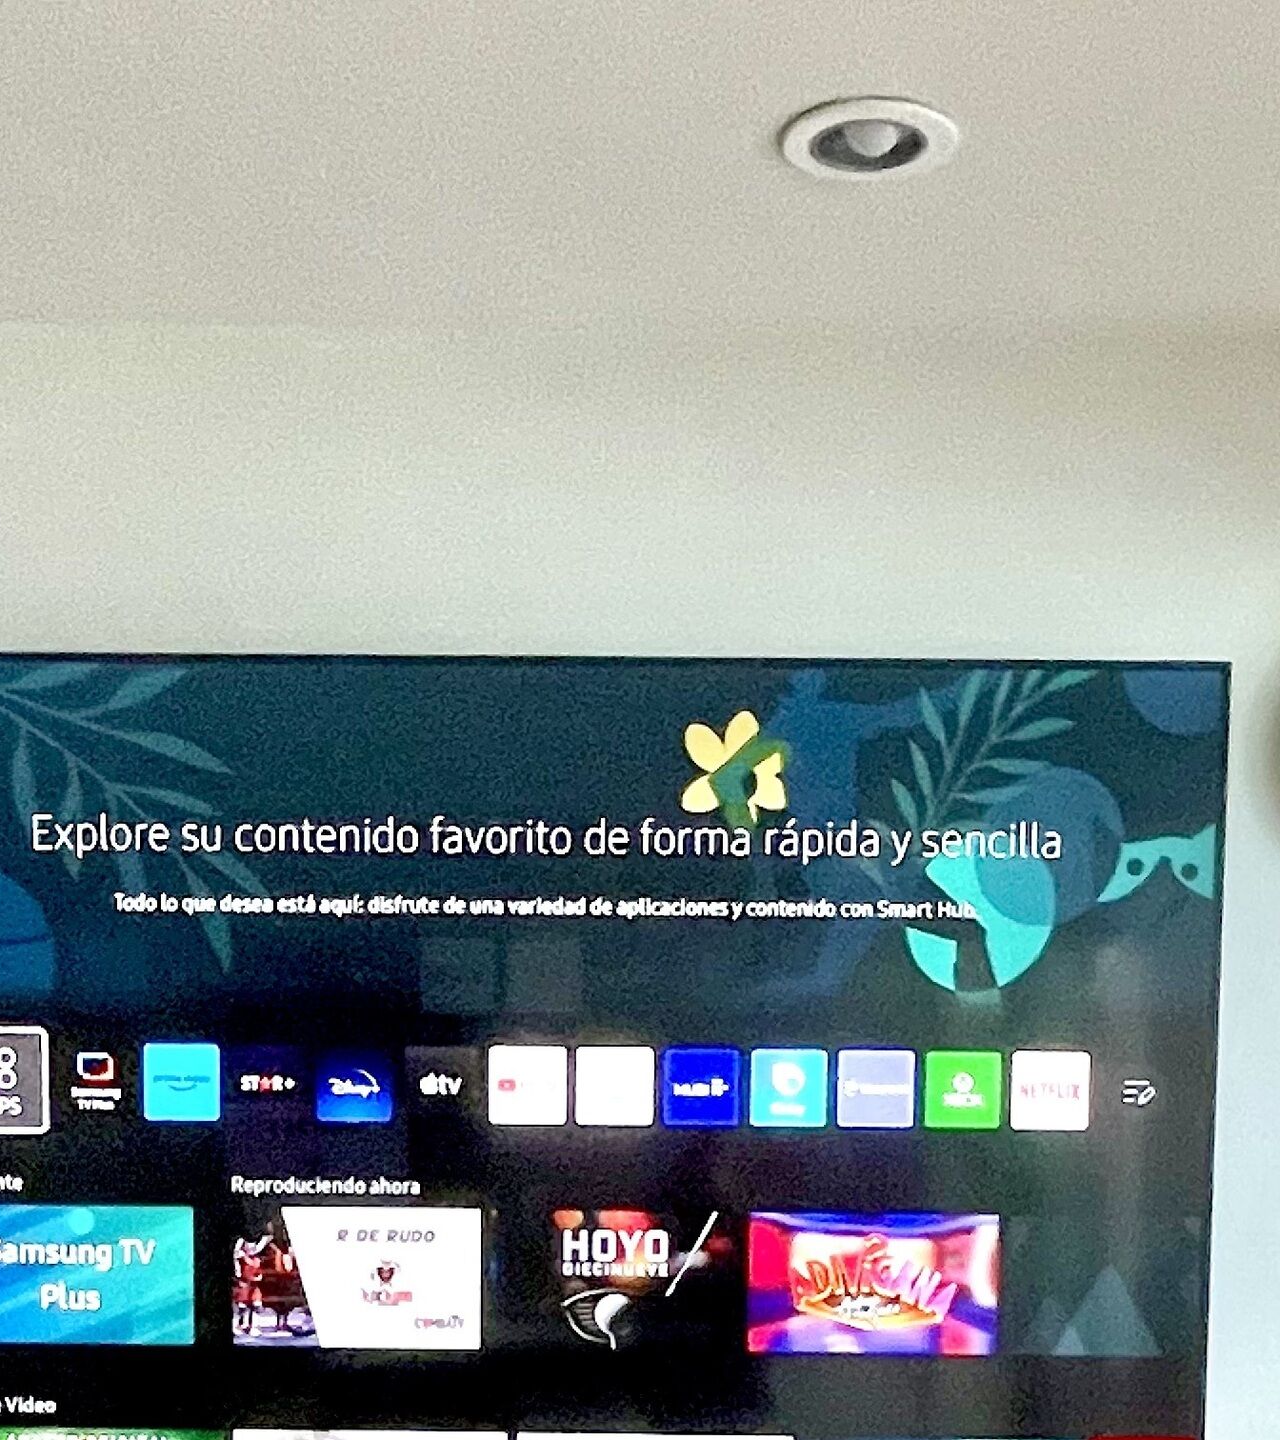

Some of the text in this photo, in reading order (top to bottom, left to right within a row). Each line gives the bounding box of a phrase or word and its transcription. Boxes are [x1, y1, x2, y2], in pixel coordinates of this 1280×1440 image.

[31, 812, 1062, 867] Explore su contenido favorito de forma rápida y sencilla
[113, 892, 158, 912] Todo
[160, 892, 179, 912] lo
[181, 896, 217, 916] que
[219, 893, 274, 913] desea
[276, 893, 317, 914] está
[367, 894, 440, 915] disfrute
[442, 895, 467, 915] de
[469, 898, 505, 916] una
[507, 896, 587, 916] variedad
[589, 896, 613, 916] de
[615, 897, 729, 920] aplicaciones
[730, 901, 744, 920] y
[745, 899, 837, 919] contenido
[839, 902, 874, 919] con
[876, 899, 933, 920] Smart
[231, 1175, 421, 1198] Reproduciendo ahora
[356, 1229, 380, 1242] DE
[385, 1229, 436, 1243] RUDO
[562, 1228, 670, 1263] HOYO
[119, 1237, 156, 1265] TV
[39, 1281, 102, 1311] Plus
[4, 1395, 57, 1414] Video
